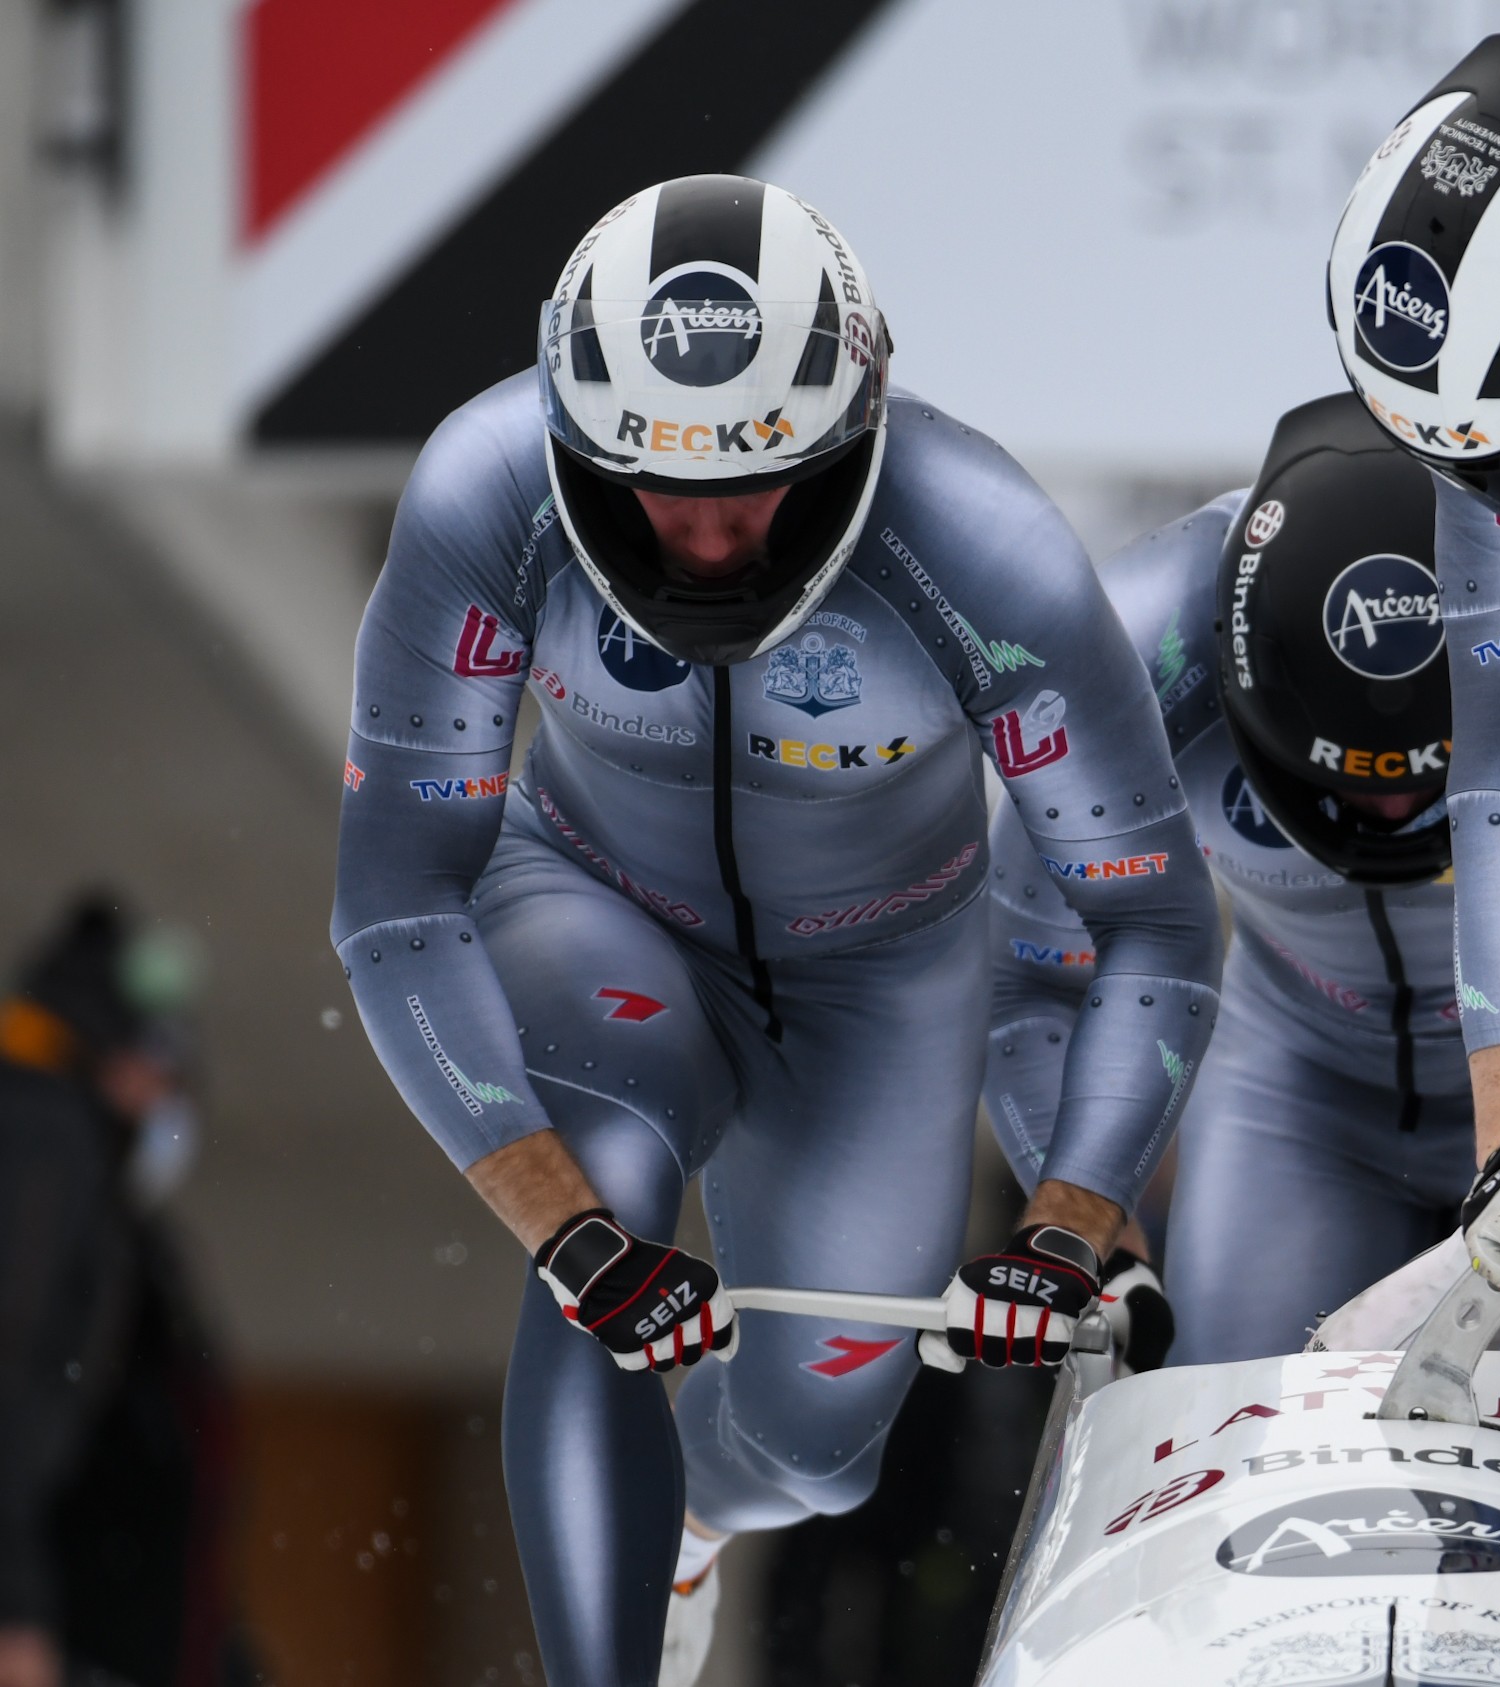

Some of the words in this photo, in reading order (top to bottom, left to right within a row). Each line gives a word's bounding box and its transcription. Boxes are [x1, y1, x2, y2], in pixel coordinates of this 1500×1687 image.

[1439, 124, 1487, 153] TECHNICAL
[616, 409, 754, 453] RECK
[880, 528, 940, 600] LATVIJAS
[820, 612, 839, 627] OF
[839, 615, 867, 642] RIGA
[1231, 552, 1262, 691] Binders
[571, 691, 697, 746] Binders
[748, 732, 869, 770] RECK
[1308, 736, 1446, 778] RECK
[478, 771, 510, 799] NE
[1102, 853, 1169, 880] NET
[407, 996, 440, 1051] LATVIJAS
[434, 1050, 462, 1090] VALSTS
[1205, 1595, 1410, 1650] FREEPORT
[1419, 1597, 1475, 1612] OF
